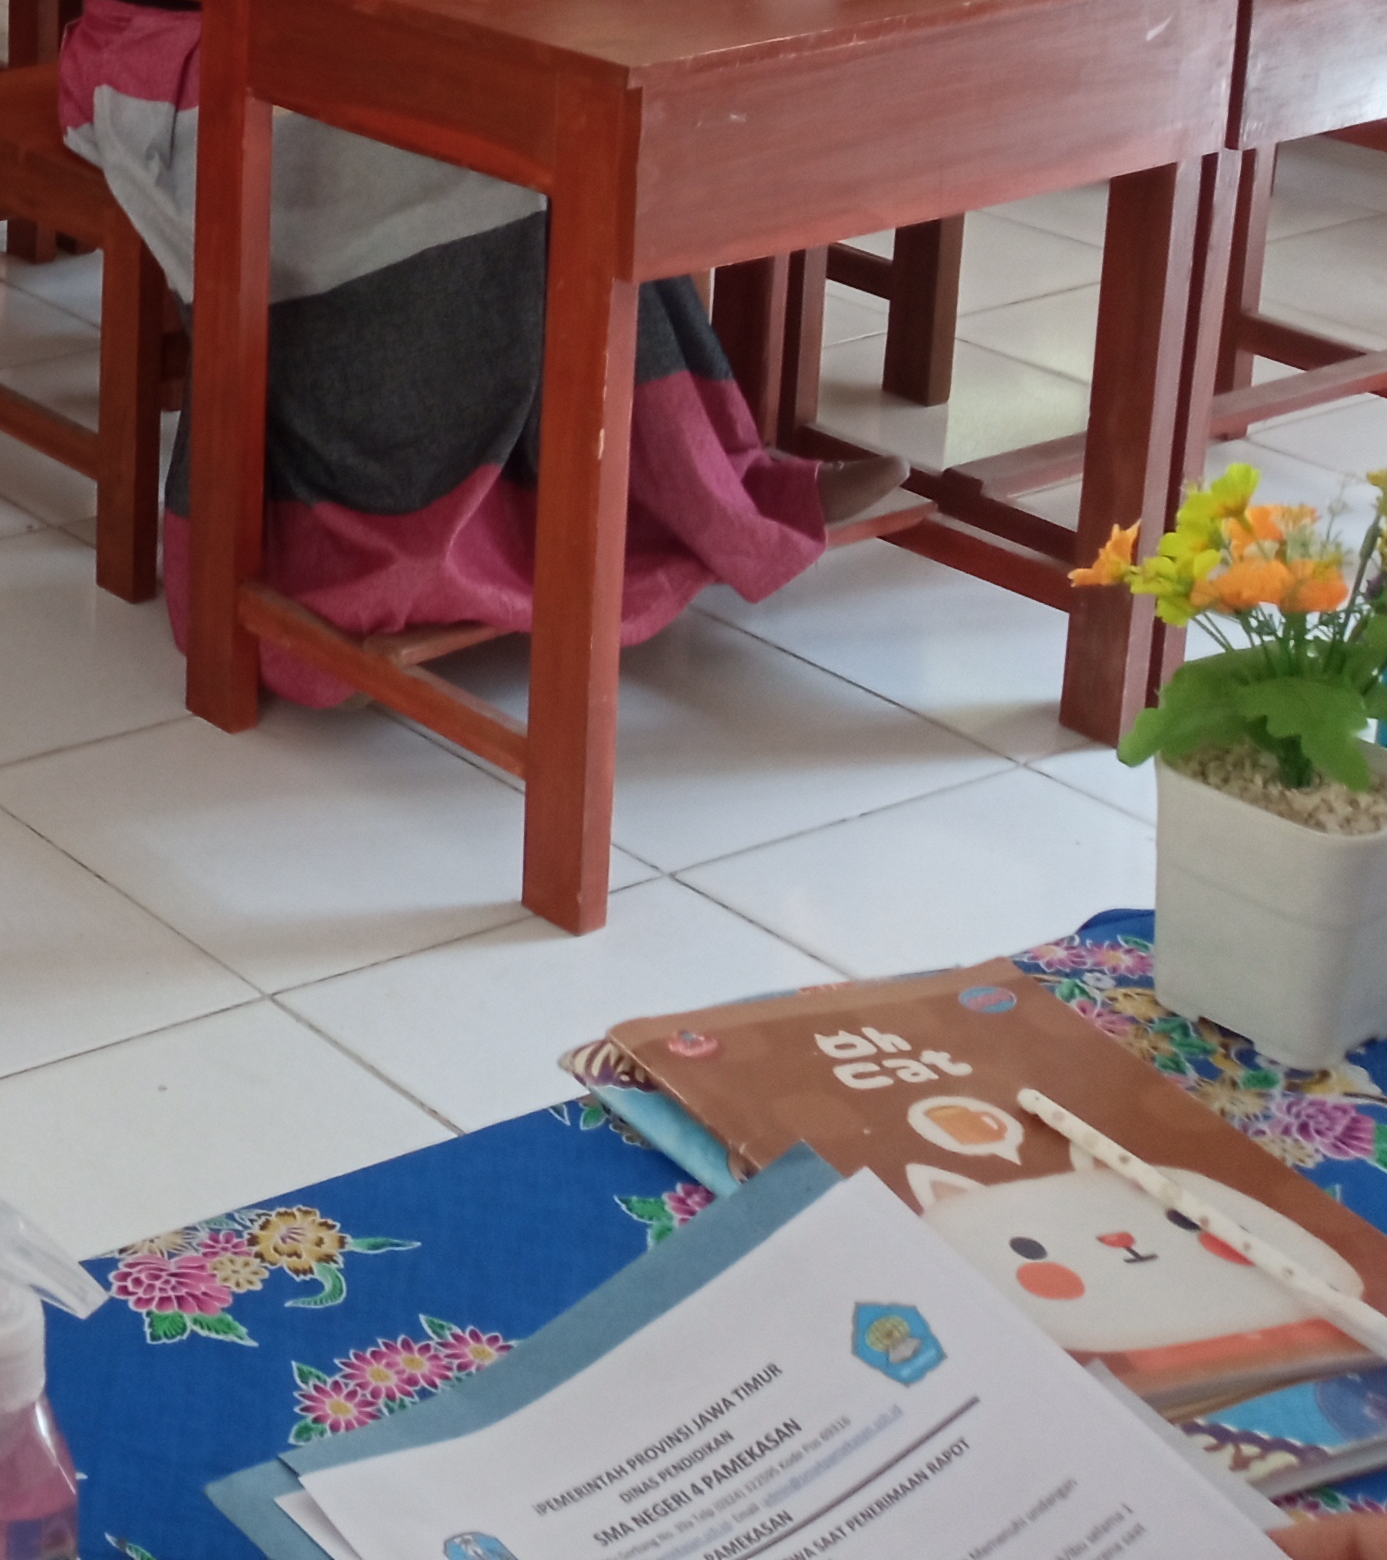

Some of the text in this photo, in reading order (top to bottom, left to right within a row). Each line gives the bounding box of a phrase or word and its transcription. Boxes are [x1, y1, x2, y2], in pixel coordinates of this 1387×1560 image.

[619, 1429, 735, 1505] DINAS PENDIDIKAN
[627, 1423, 694, 1474] PROVINSI
[693, 1396, 735, 1433] JAWA
[730, 1361, 783, 1403] TIMUR
[593, 1518, 635, 1548] SMA
[630, 1488, 693, 1537] NEGERI
[689, 1480, 706, 1498] 4
[700, 1417, 804, 1491] PAMEKASAN
[812, 1524, 848, 1553] SAAT
[844, 1468, 931, 1533] PENERIMAAN
[926, 1437, 972, 1476] RAPOT
